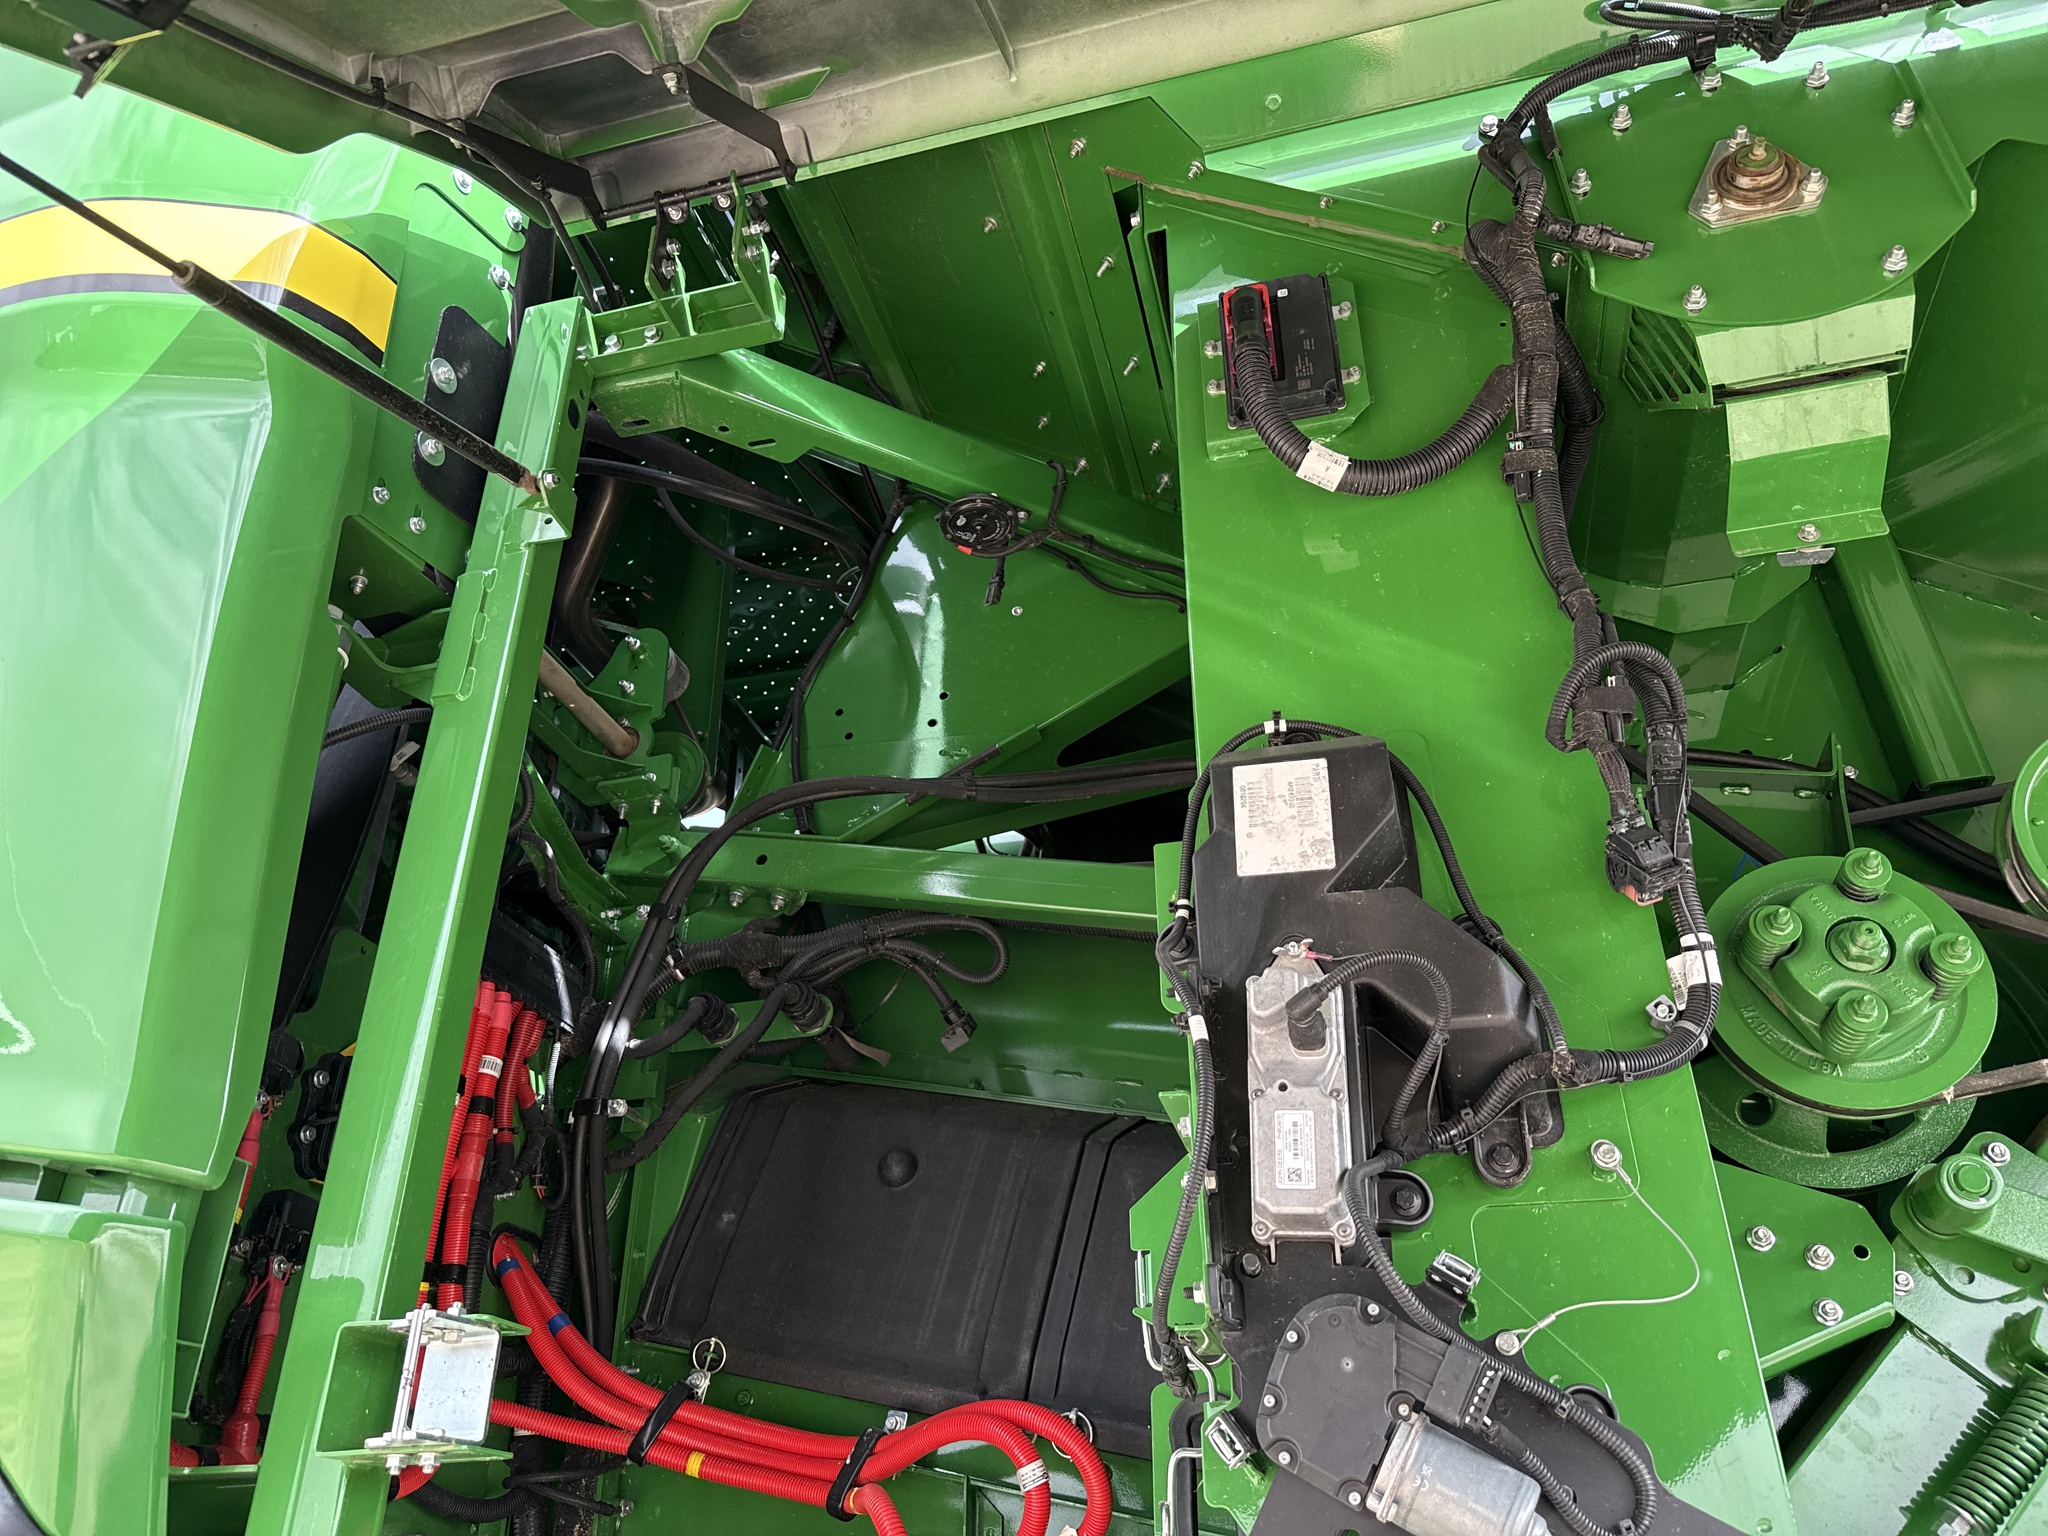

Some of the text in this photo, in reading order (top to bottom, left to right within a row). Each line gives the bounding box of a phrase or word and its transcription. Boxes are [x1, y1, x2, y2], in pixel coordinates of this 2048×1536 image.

[1740, 1005, 1845, 1078] MADE IN USA
